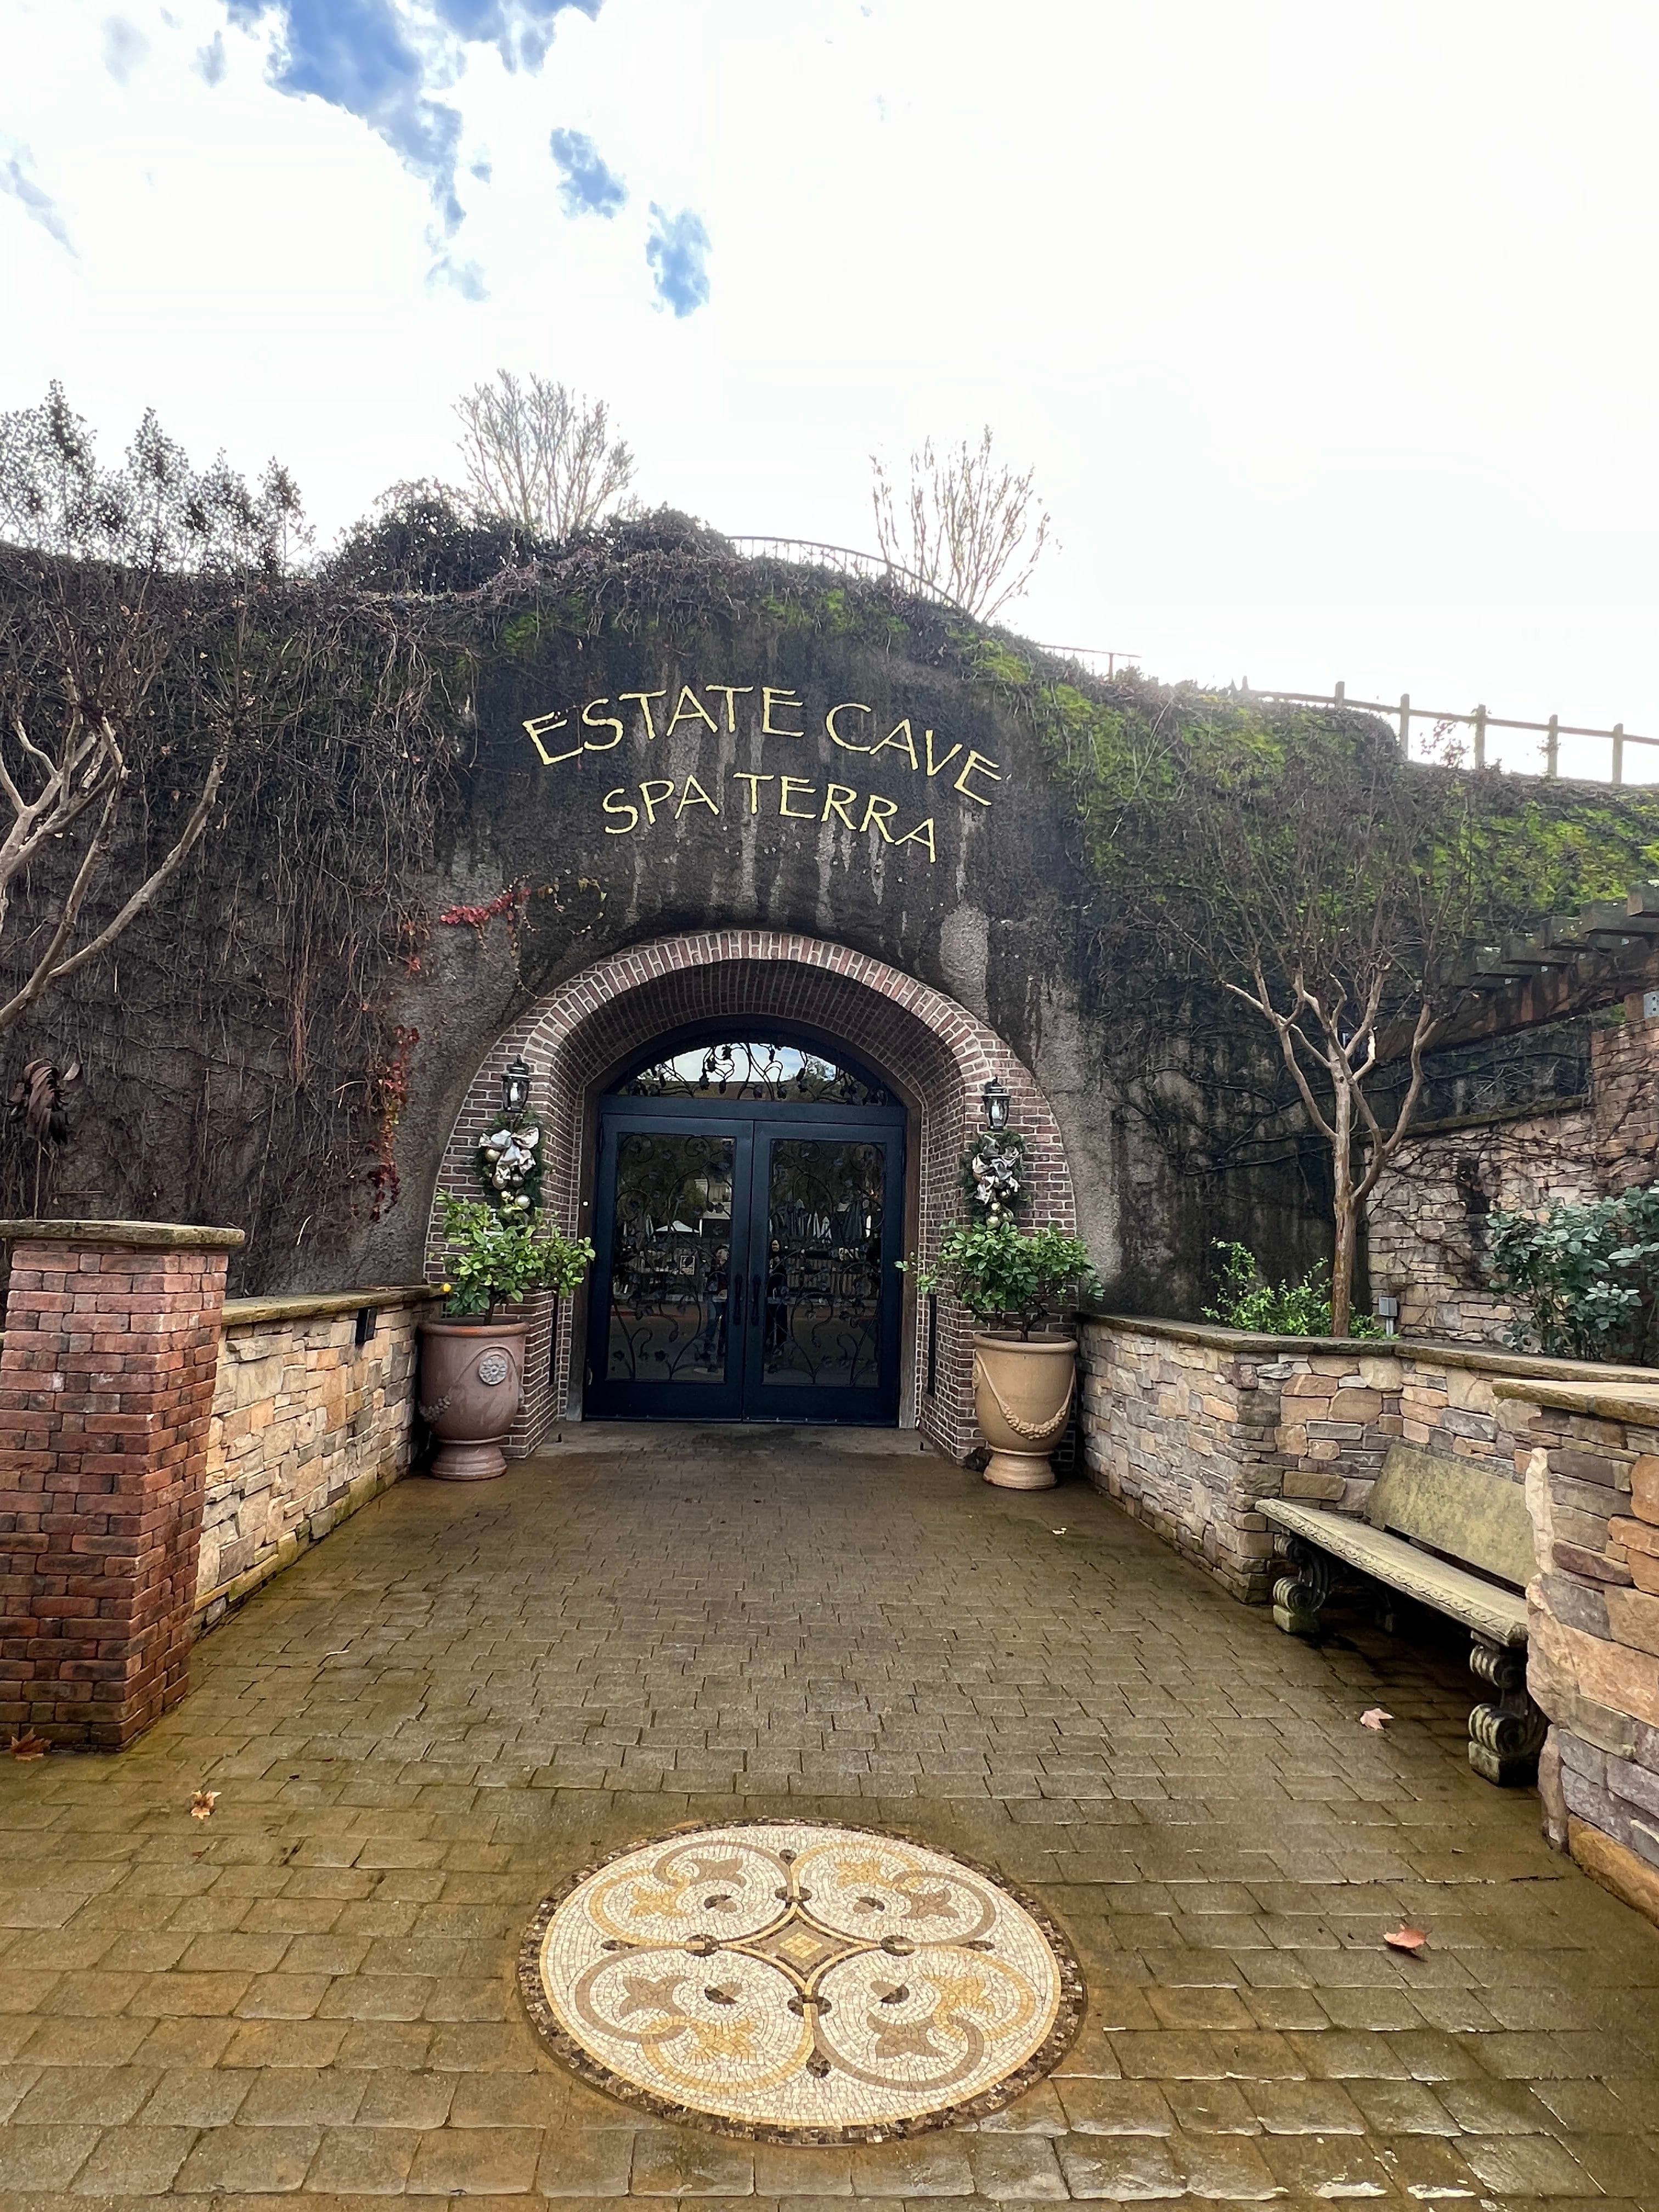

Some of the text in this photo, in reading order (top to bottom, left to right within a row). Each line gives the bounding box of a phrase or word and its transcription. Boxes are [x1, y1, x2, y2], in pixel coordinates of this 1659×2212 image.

[522, 685, 1002, 806] ESTATE CAVE
[603, 772, 936, 863] SPA TERRA
